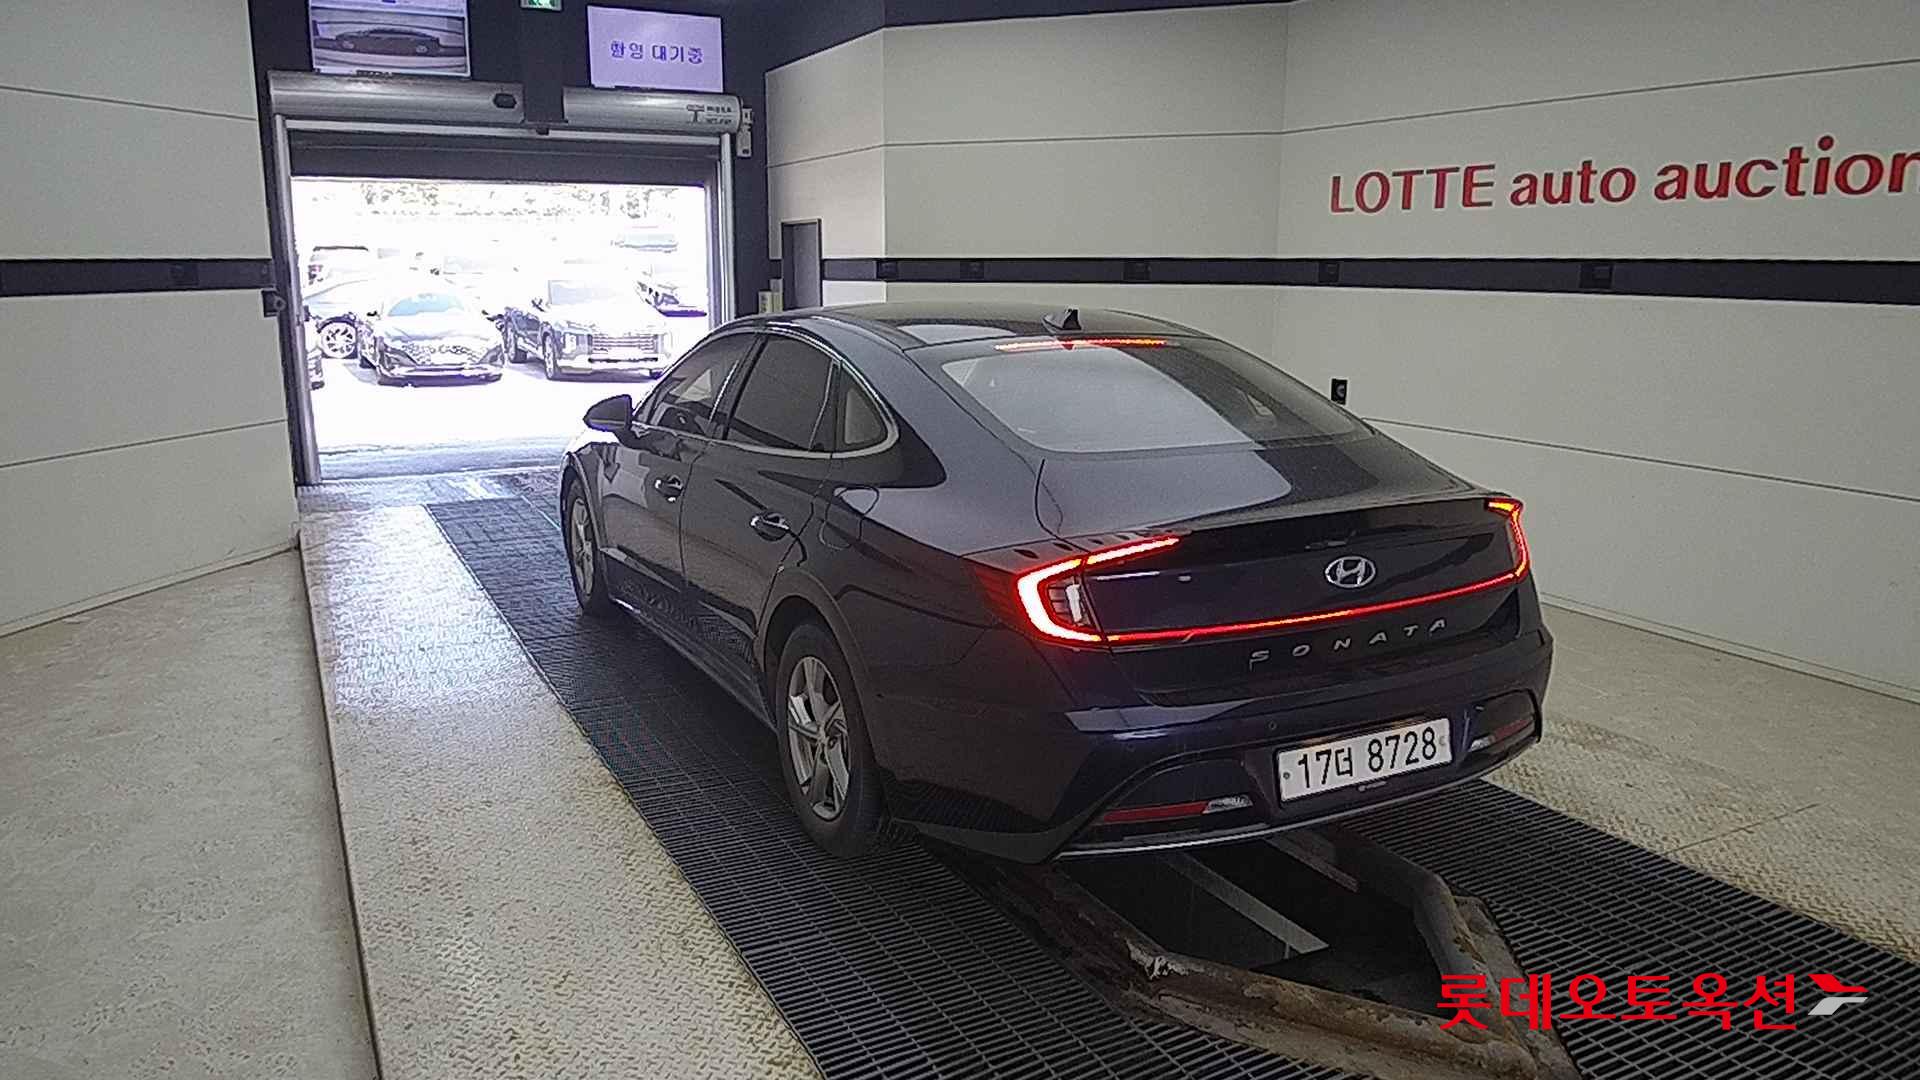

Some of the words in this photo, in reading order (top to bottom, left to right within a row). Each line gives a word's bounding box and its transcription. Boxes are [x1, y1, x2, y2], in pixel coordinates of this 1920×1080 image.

[1330, 164, 1496, 213] LOTTE
[1509, 160, 1637, 206] auto
[1653, 135, 1920, 201] auction
[1249, 619, 1449, 666] SONATA
[1298, 747, 1353, 789] 17더
[1367, 726, 1437, 773] 8728
